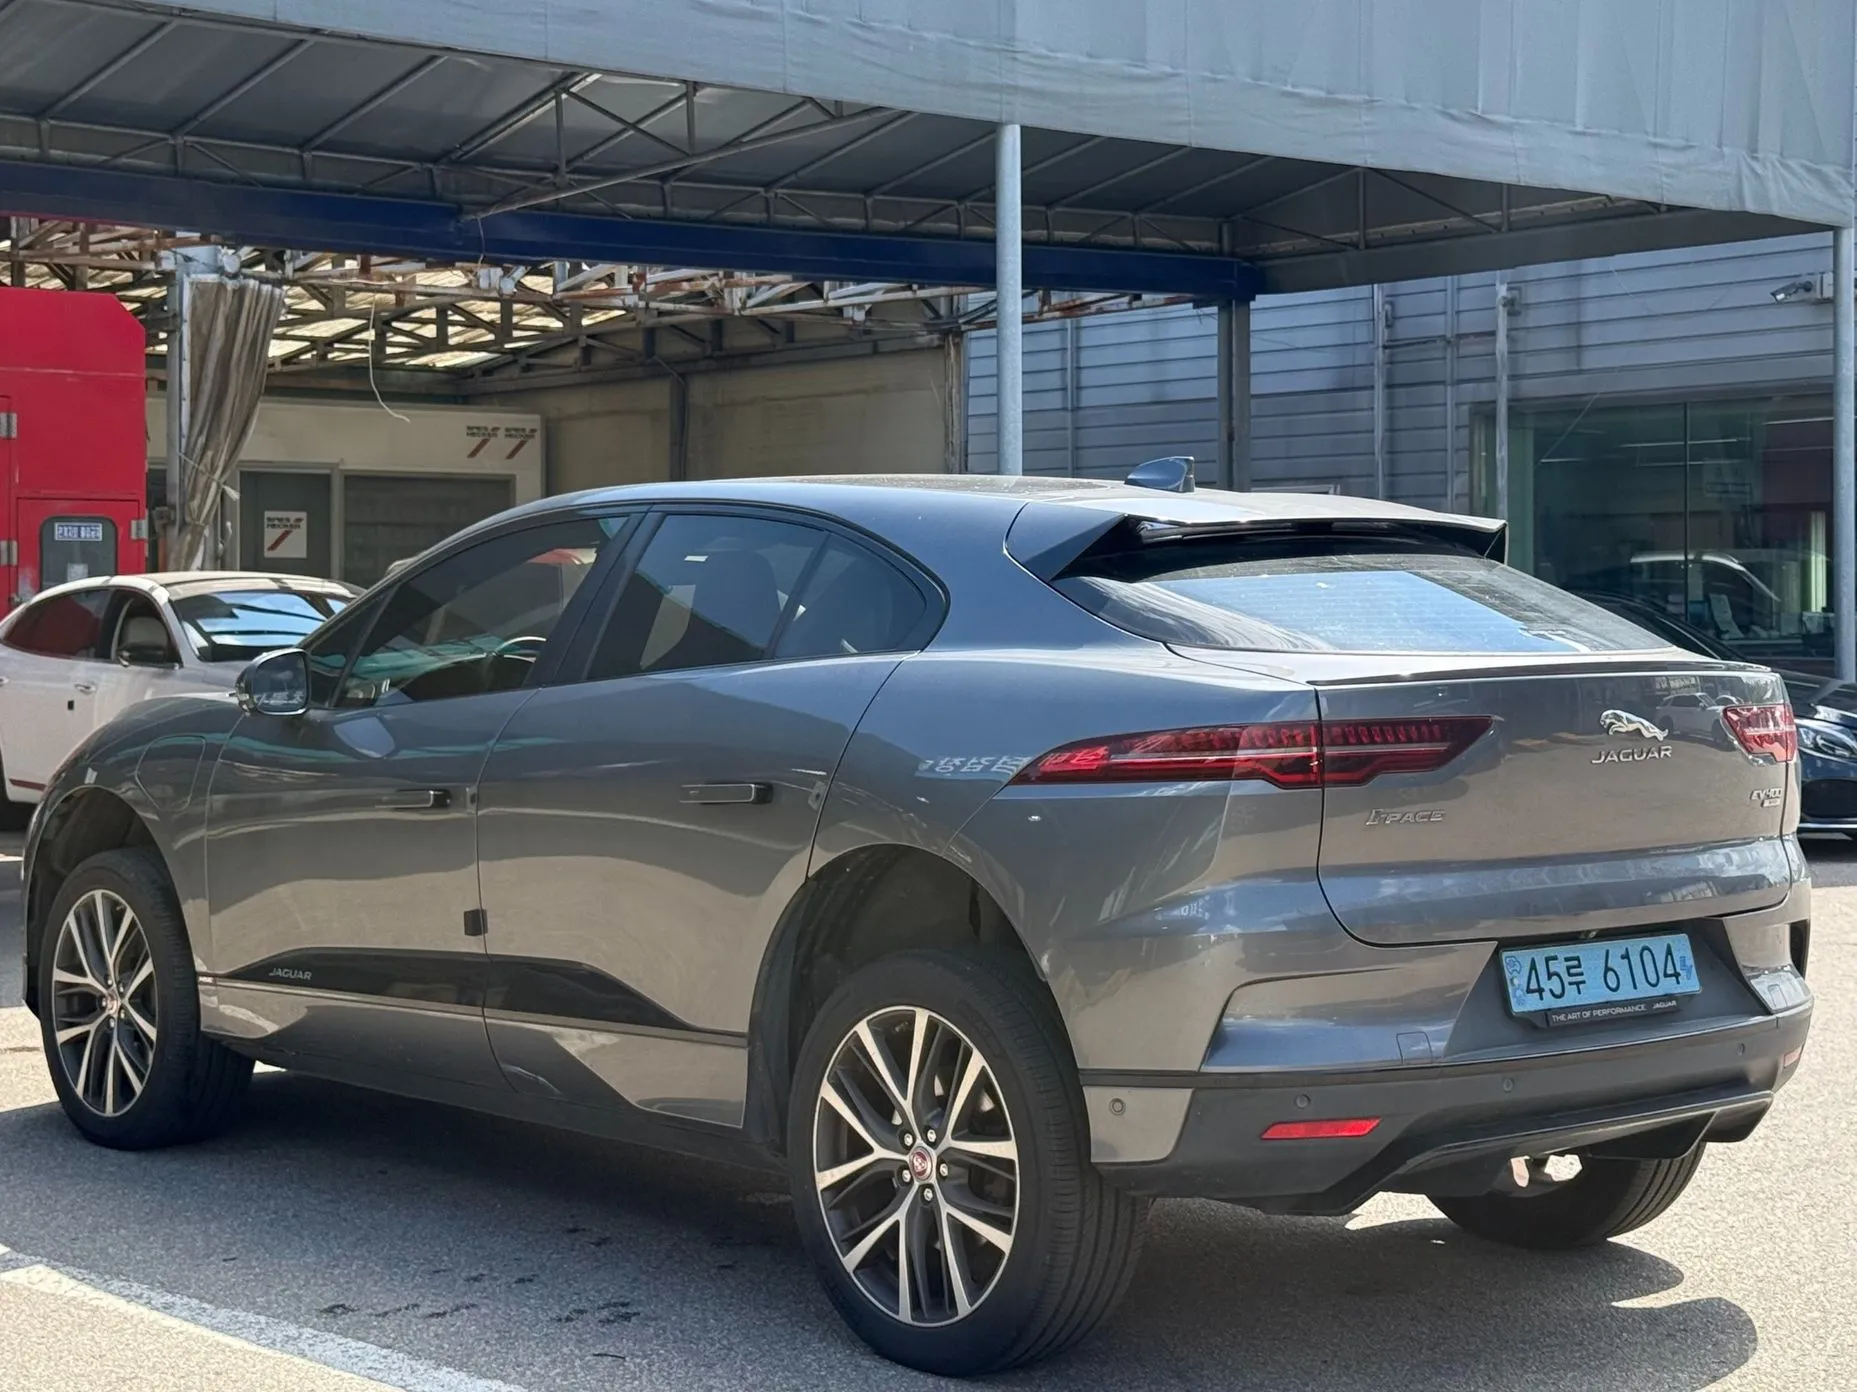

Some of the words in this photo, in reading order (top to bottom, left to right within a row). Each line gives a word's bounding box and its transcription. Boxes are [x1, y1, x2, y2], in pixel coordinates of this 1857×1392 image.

[1591, 745, 1673, 764] JAGUAR
[268, 967, 313, 981] JAGUAR
[1603, 943, 1682, 992] 6104
[1552, 1014, 1567, 1022] THE
[1567, 1011, 1581, 1020] ART
[1582, 1010, 1591, 1018] OF
[1592, 1004, 1647, 1017] PERFORMANCE
[1652, 1000, 1677, 1009] JAGUAR
